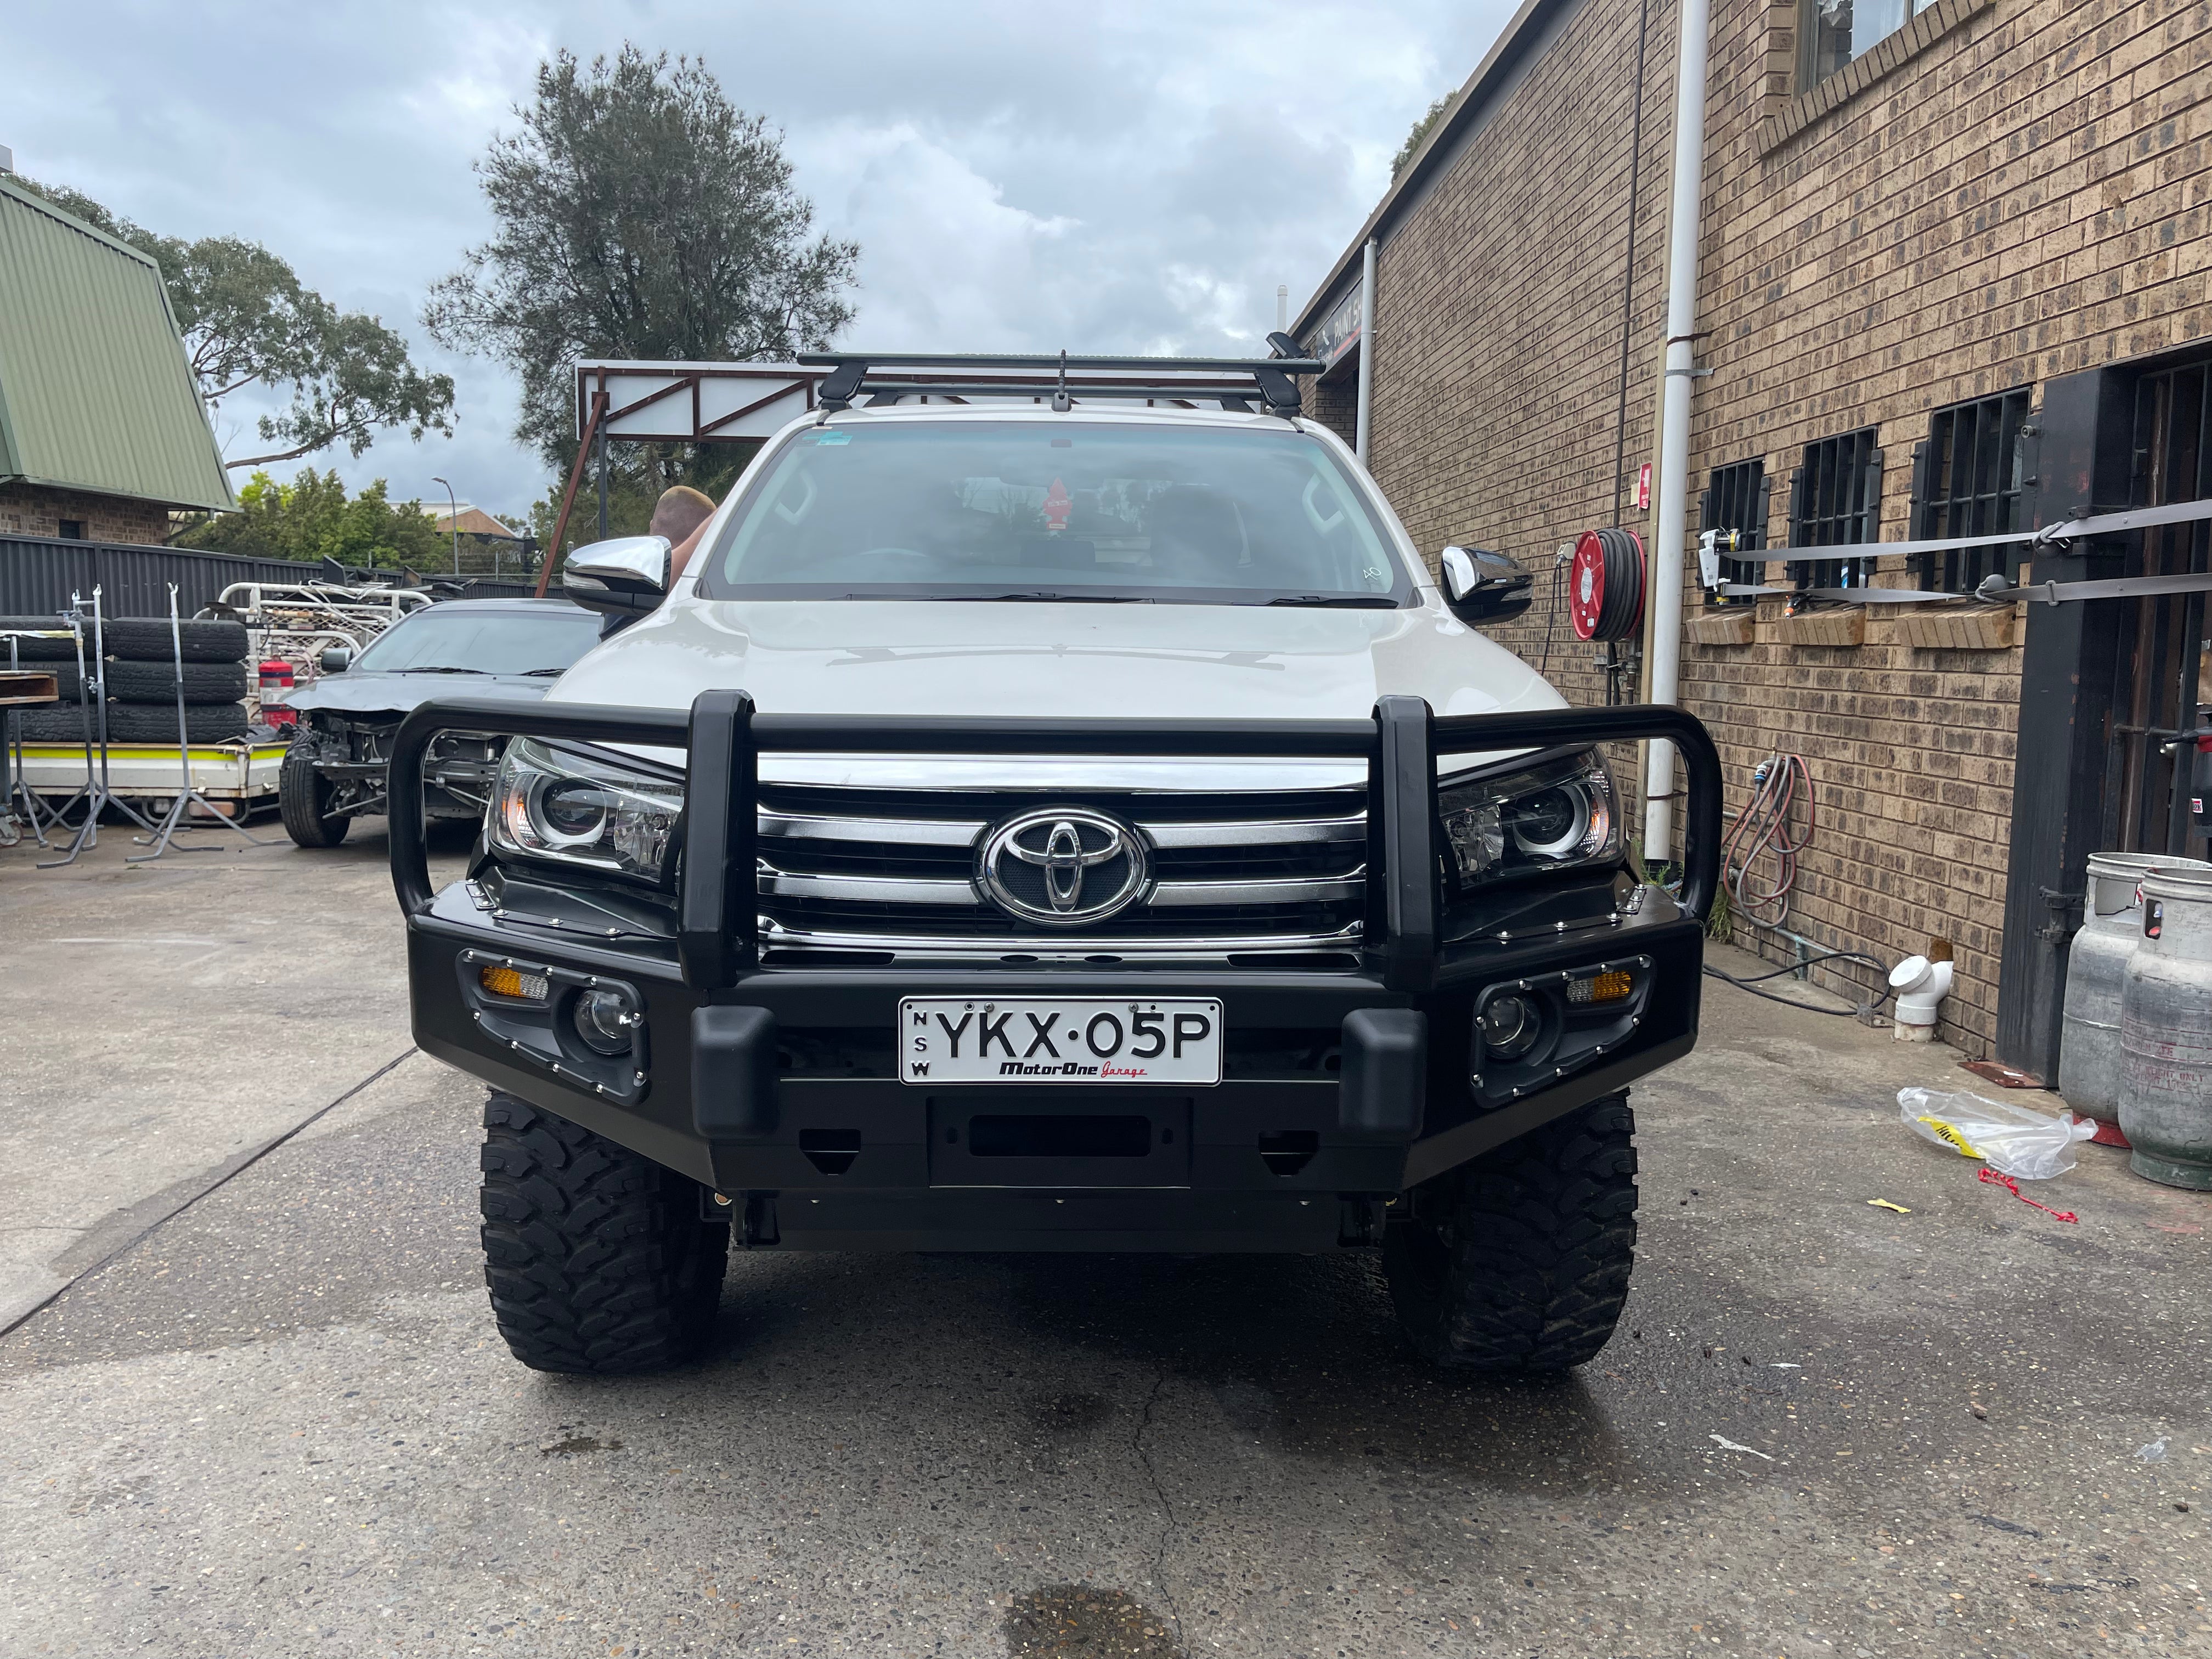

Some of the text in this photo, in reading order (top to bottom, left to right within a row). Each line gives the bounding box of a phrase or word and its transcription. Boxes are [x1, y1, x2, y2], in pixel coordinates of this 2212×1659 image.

[1334, 294, 1362, 347] PAINT SH
[999, 1061, 1148, 1078] MotorOne Garage
